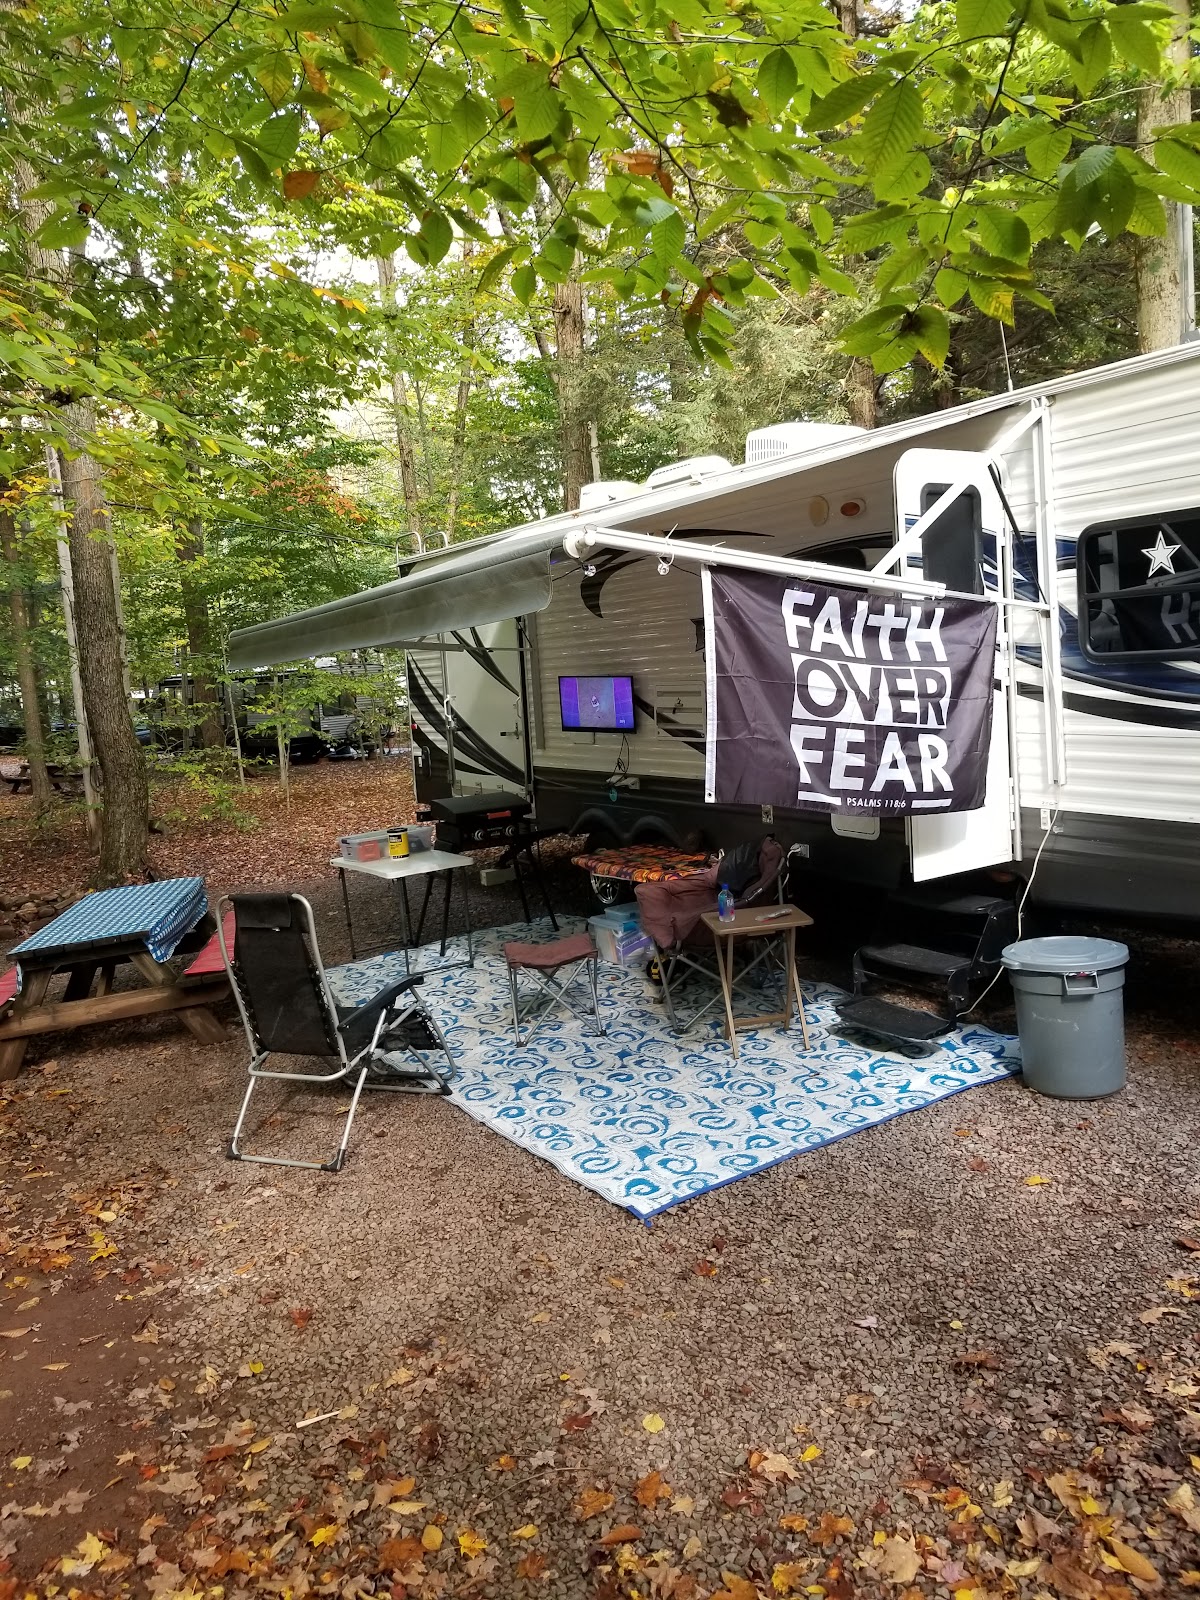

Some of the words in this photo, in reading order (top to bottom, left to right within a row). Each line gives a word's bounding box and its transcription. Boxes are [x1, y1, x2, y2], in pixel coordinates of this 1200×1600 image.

[796, 658, 948, 726] OVER
[790, 723, 954, 793] FEAR
[846, 797, 882, 808] PSALMS
[884, 799, 907, 809] 118:6
